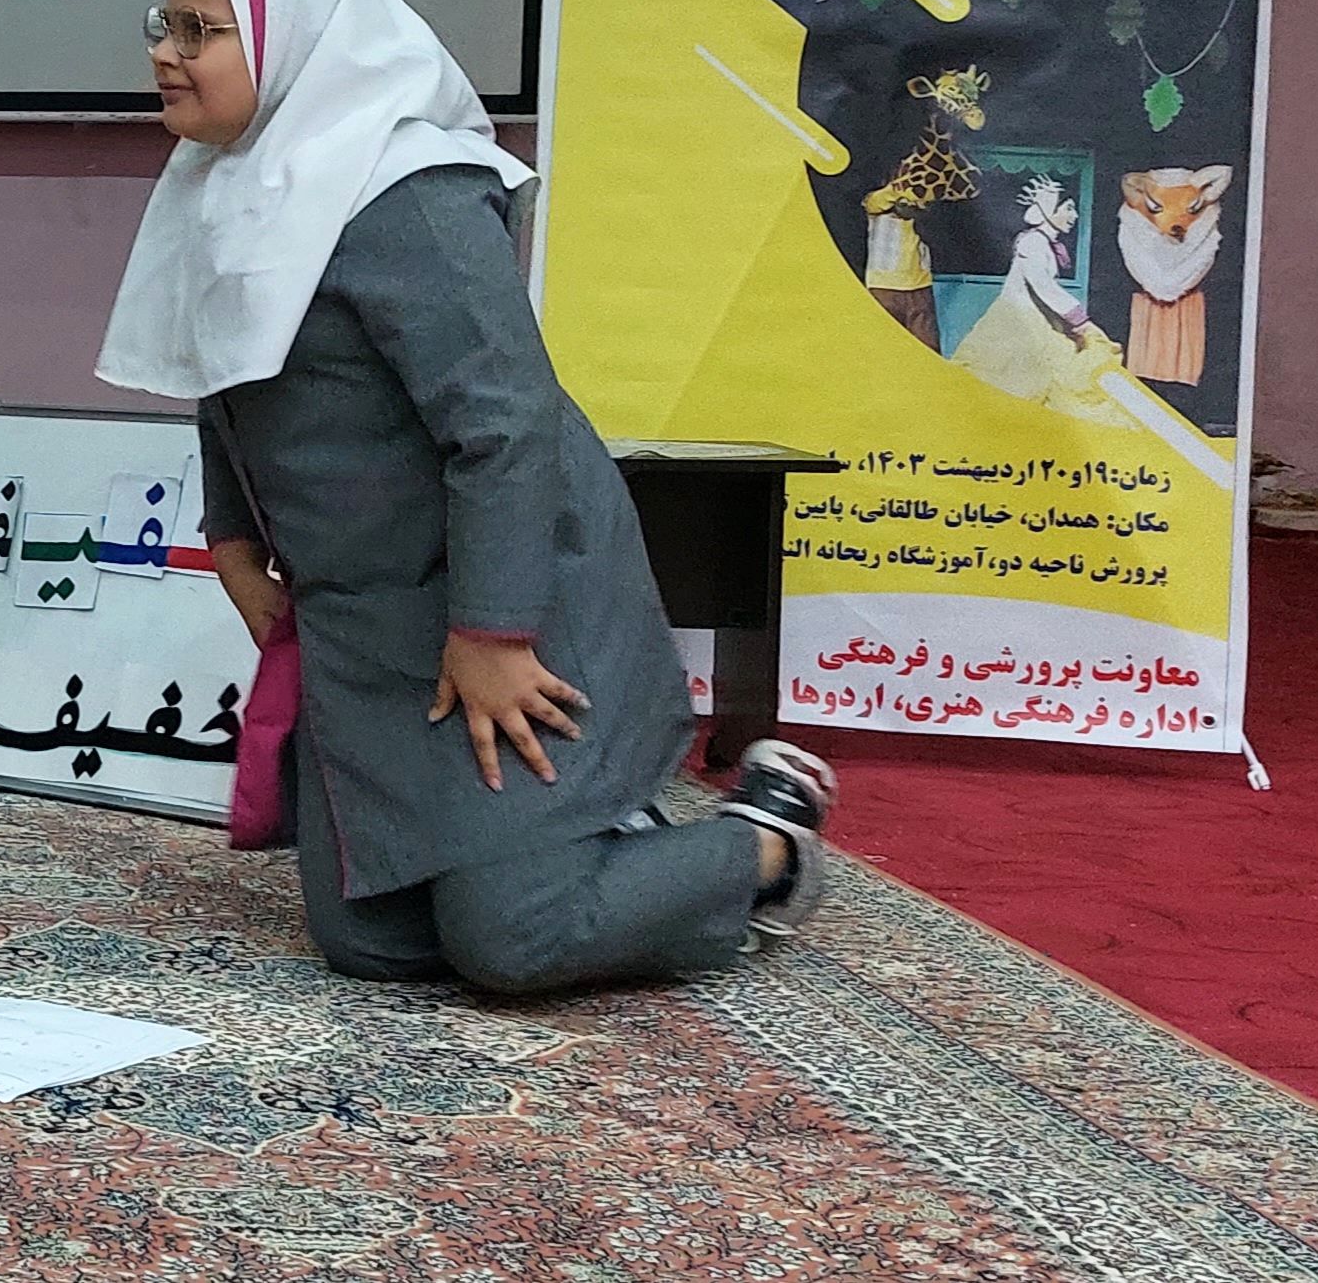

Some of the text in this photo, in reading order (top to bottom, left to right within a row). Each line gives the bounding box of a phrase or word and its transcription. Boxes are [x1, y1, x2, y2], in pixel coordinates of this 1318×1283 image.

[931, 455, 1035, 485] اردیبهشت
[795, 494, 845, 521] پایین
[850, 497, 939, 524] طالقانی،
[943, 502, 1013, 530] خیابان
[1020, 507, 1100, 533] همدان،
[1106, 512, 1170, 537] مکان:
[816, 542, 881, 570] ریحانه
[1028, 553, 1085, 577] ناحیه
[1090, 557, 1168, 588] پرورش
[817, 637, 1201, 694] معاونت پرورشی و فرهنگی
[790, 676, 1199, 738] اداره فرهنگی هنری، اردوها
